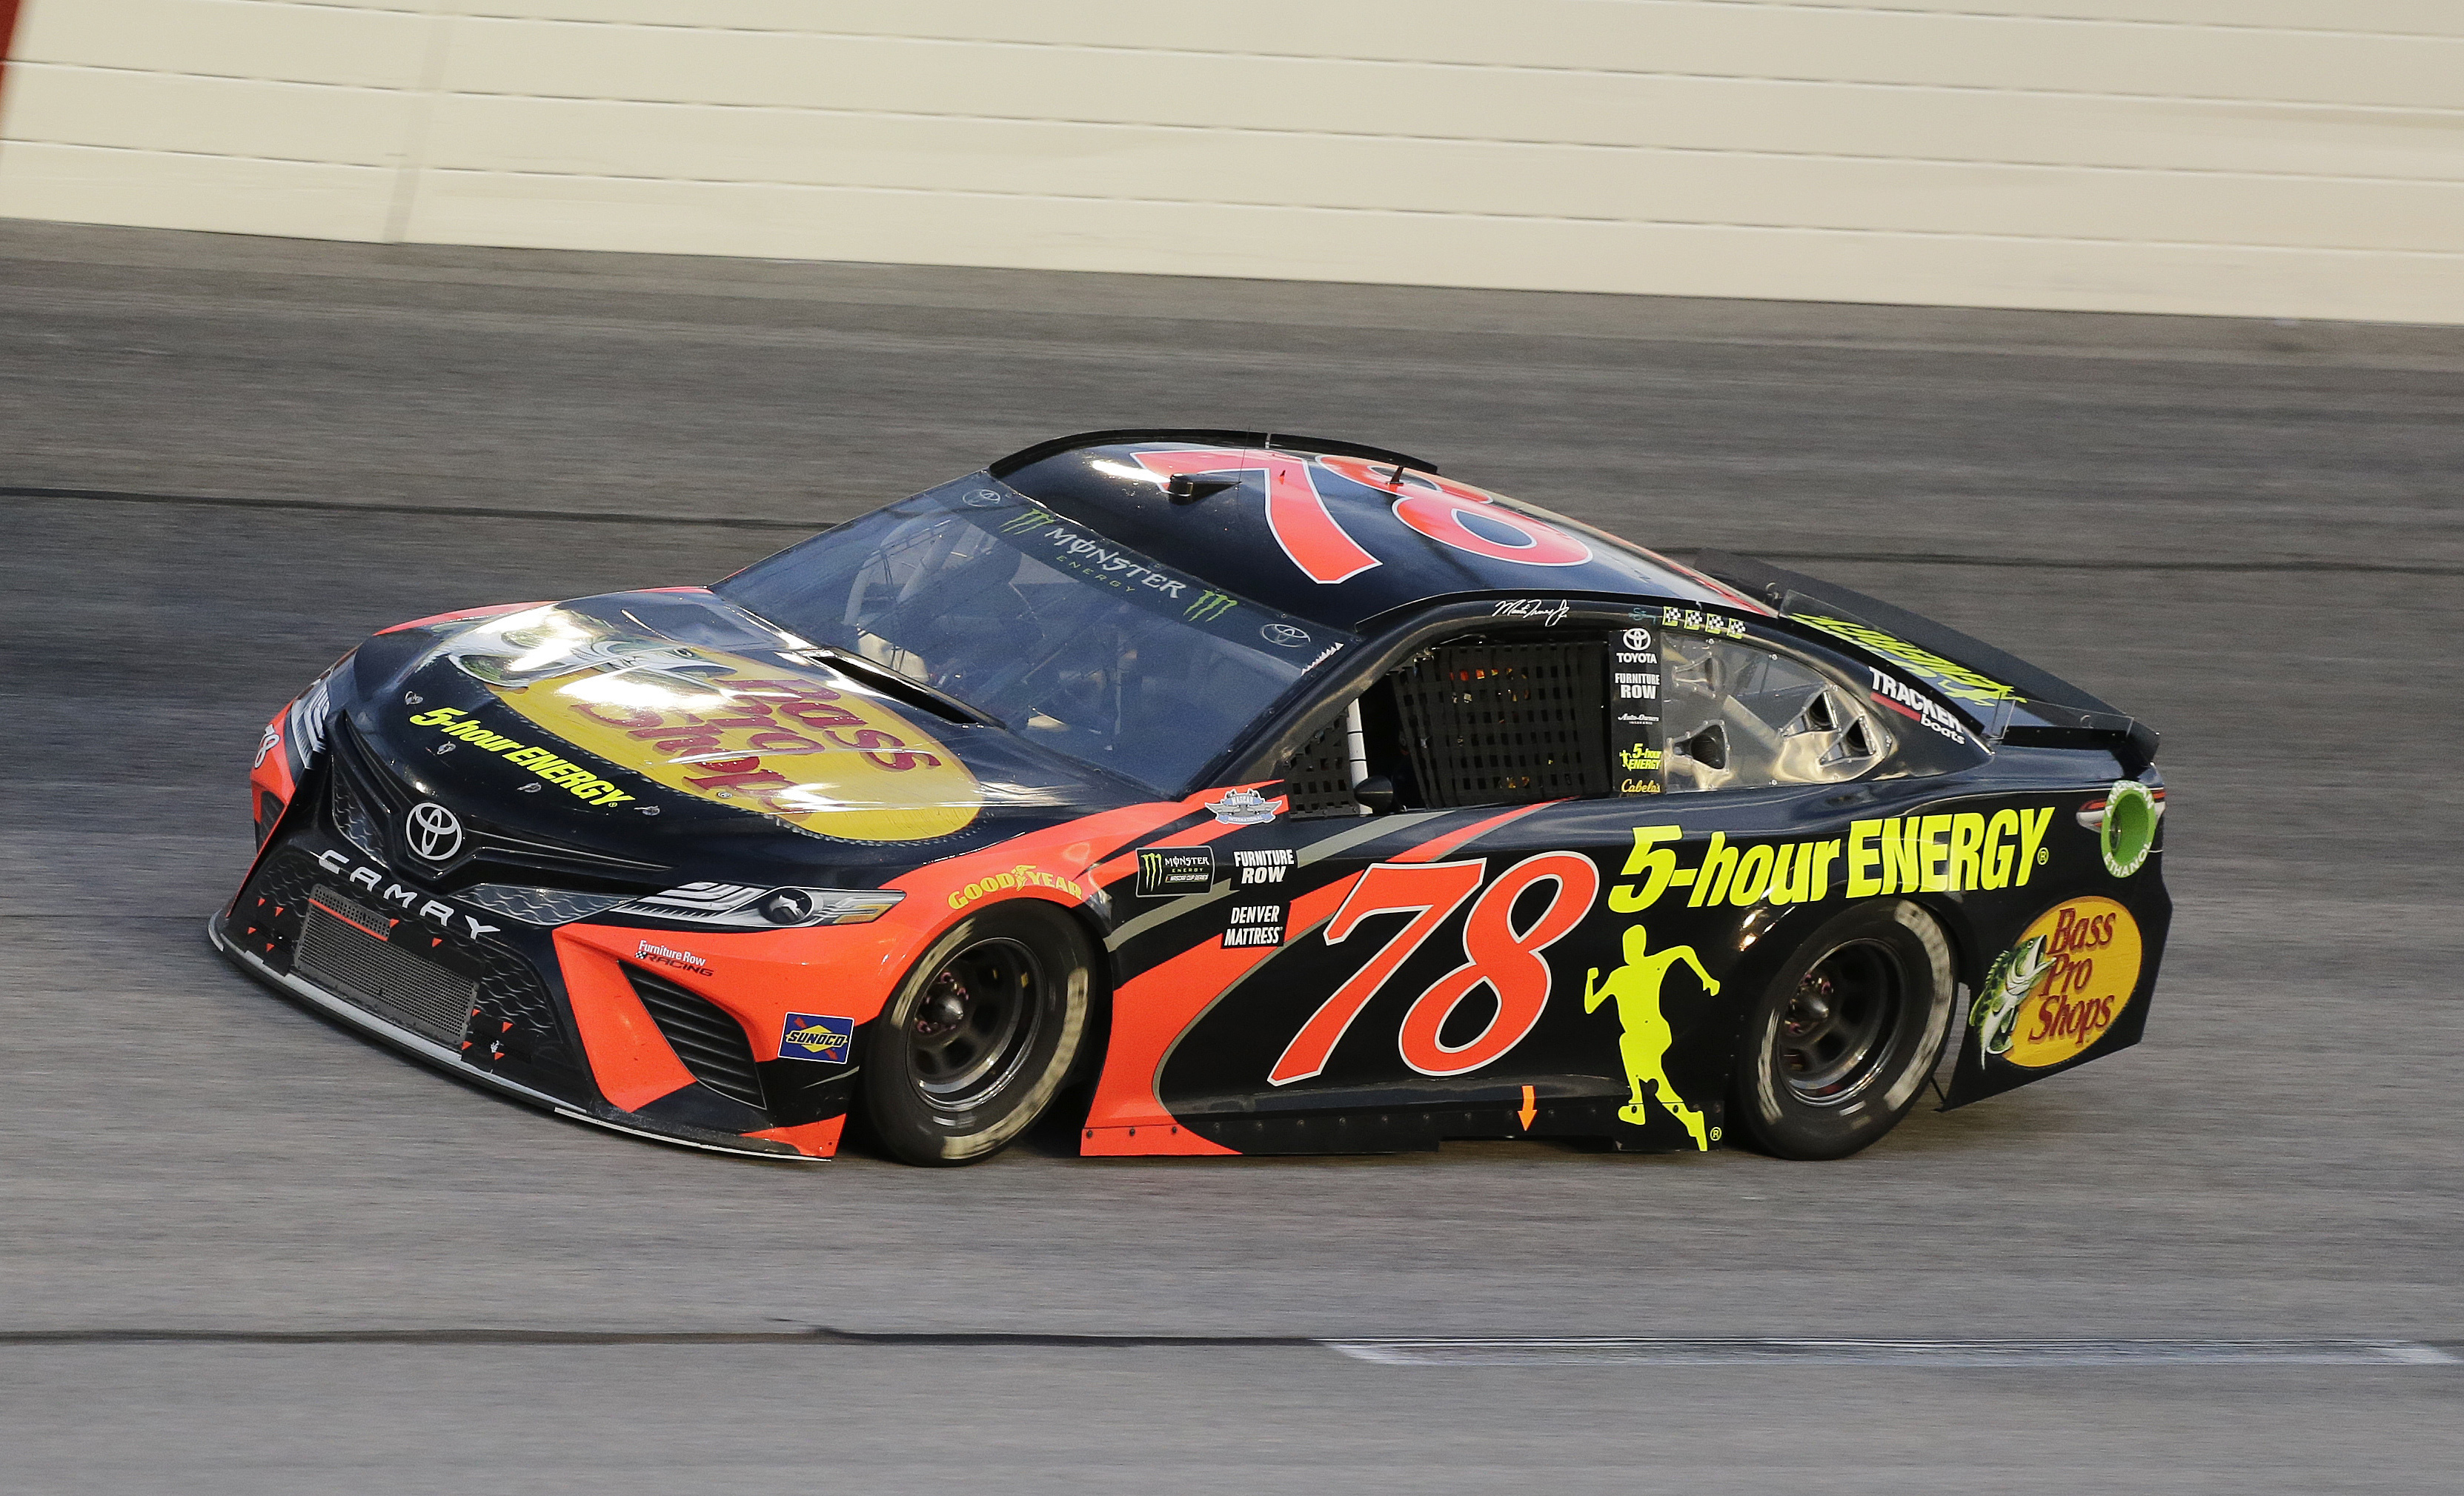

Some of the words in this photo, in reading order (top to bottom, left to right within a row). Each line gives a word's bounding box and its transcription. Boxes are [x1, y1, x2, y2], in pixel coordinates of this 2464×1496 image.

[1129, 449, 1593, 584] 78
[1056, 555, 1135, 592] ENERGY
[1616, 652, 1658, 664] TOYOTA
[1615, 673, 1660, 685] FURNITURE
[1620, 684, 1657, 699] ROW
[1868, 665, 1964, 734] TRACKER
[1920, 713, 1965, 745] boats
[409, 707, 525, 752] 5-hour
[502, 746, 636, 805] ENERGY
[1629, 759, 1661, 770] ENERGY
[1632, 742, 1662, 759] 5-hour
[1233, 848, 1295, 867] FURNITURE
[1607, 824, 1841, 914] 5-hour
[1845, 806, 2056, 899] ENERGY
[2104, 842, 2152, 877] ETHANOL
[1241, 865, 1286, 884] ROW
[318, 848, 502, 940] CAMRY
[1230, 905, 1281, 925] DENVER
[1223, 925, 1281, 946] MATTRESS
[2045, 908, 2116, 955] Bass
[638, 940, 683, 961] Furniture
[683, 950, 706, 967] Row
[645, 952, 714, 977] RACING
[1267, 850, 1600, 1086] 78
[2039, 953, 2093, 997] Pro
[2028, 994, 2115, 1045] Shops
[787, 1031, 847, 1047] SUNOCO
